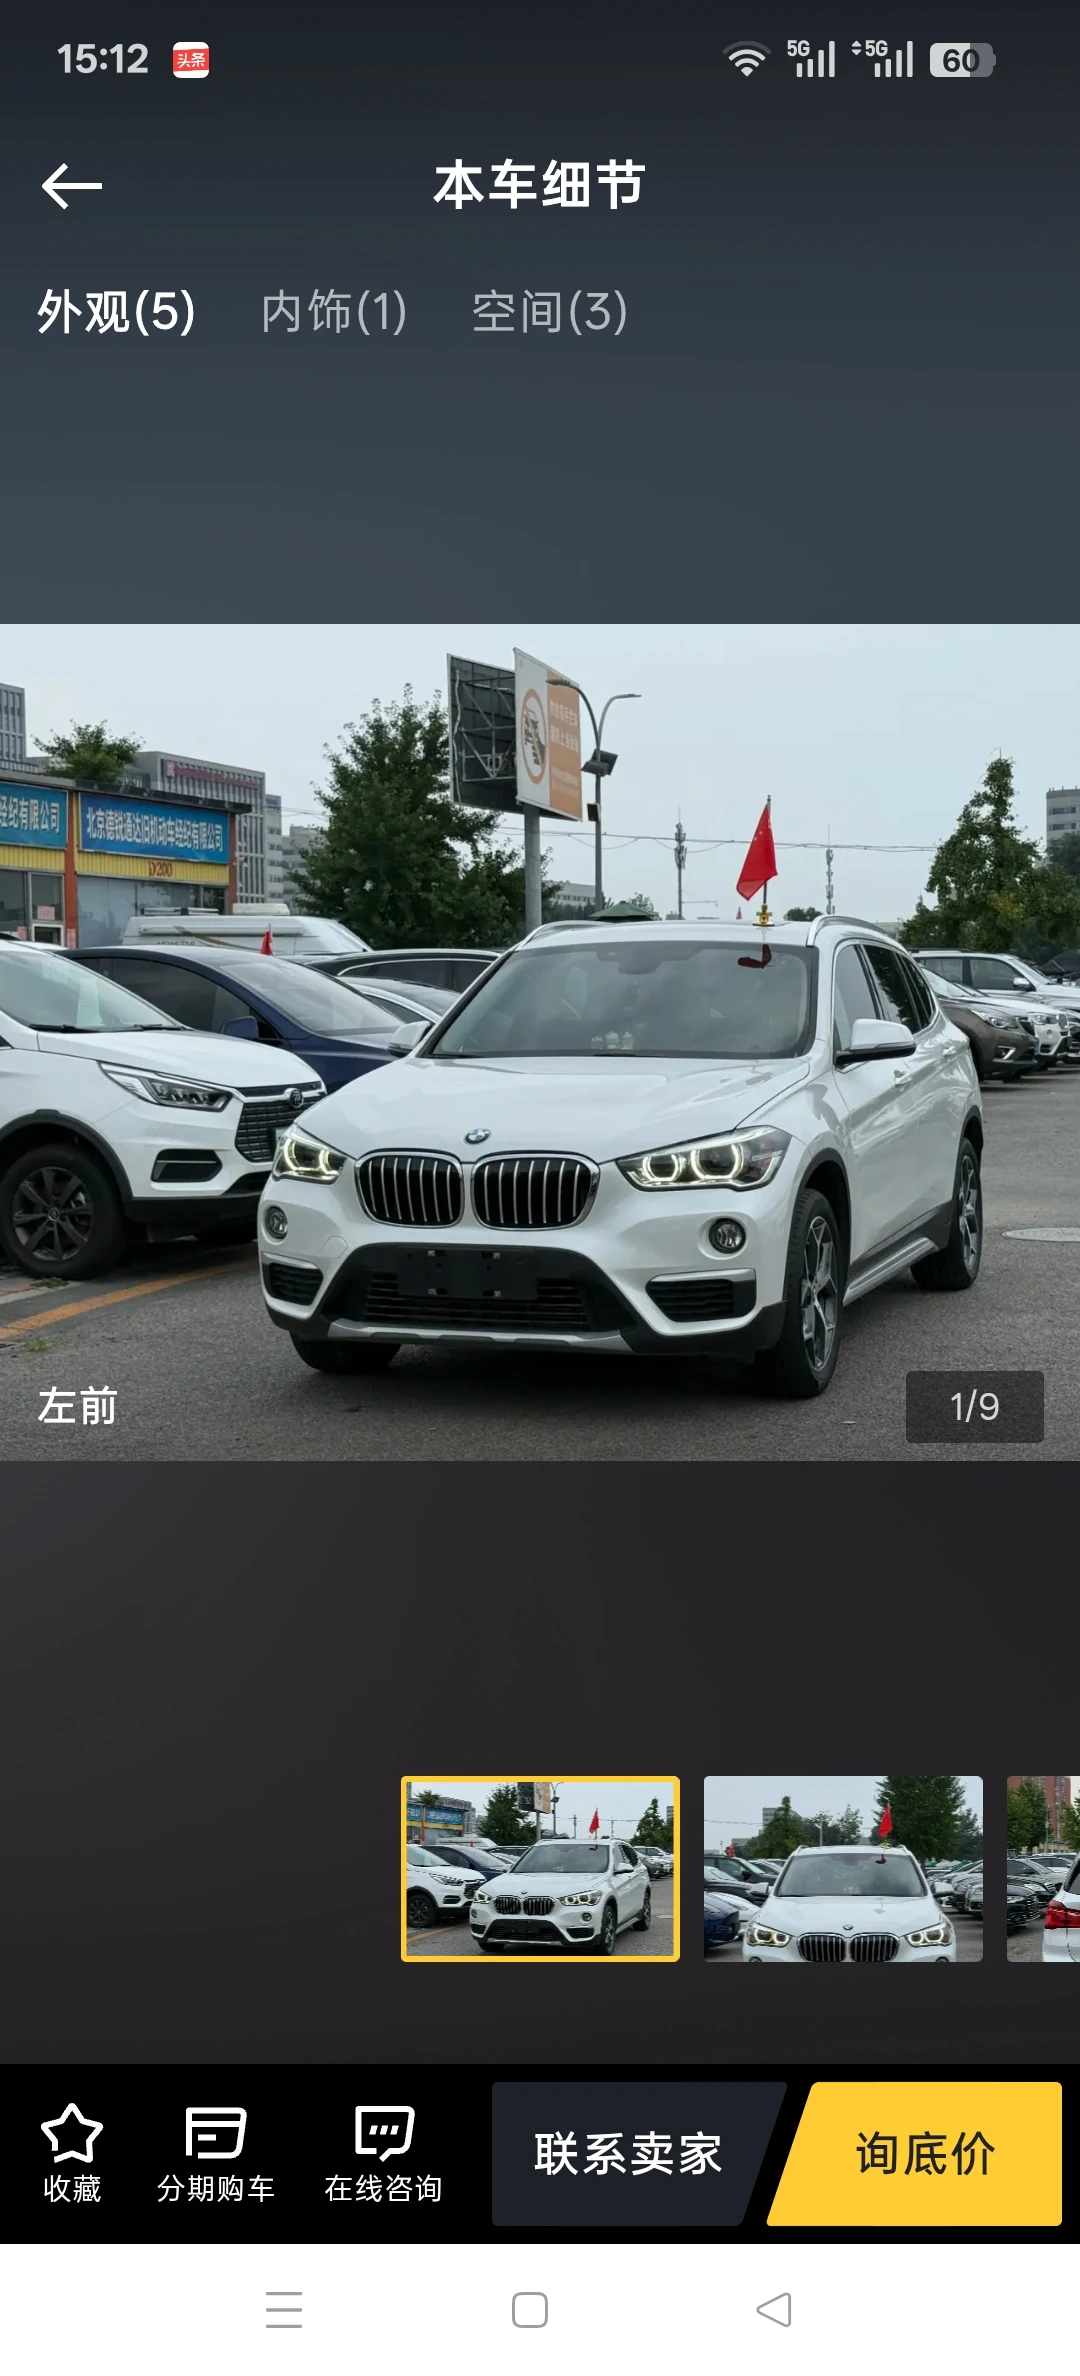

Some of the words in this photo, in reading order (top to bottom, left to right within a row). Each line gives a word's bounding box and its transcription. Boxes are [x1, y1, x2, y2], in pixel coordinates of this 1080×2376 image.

[57, 43, 149, 74] 15:12
[177, 52, 206, 69] 头条
[787, 39, 811, 57] 5G
[865, 39, 889, 57] 5G
[942, 48, 980, 73] 60
[432, 157, 646, 210] 本车细节
[36, 288, 195, 337] 外观(5)
[262, 288, 407, 337] 内饰(1)
[471, 288, 628, 337] 空间(3)
[148, 861, 173, 877] D200
[533, 2130, 723, 2176] 联系卖家
[856, 2130, 996, 2176] 询底价
[43, 2173, 102, 2204] 收藏
[156, 2173, 275, 2203] 分期购车
[324, 2173, 442, 2203] 在线咨询
